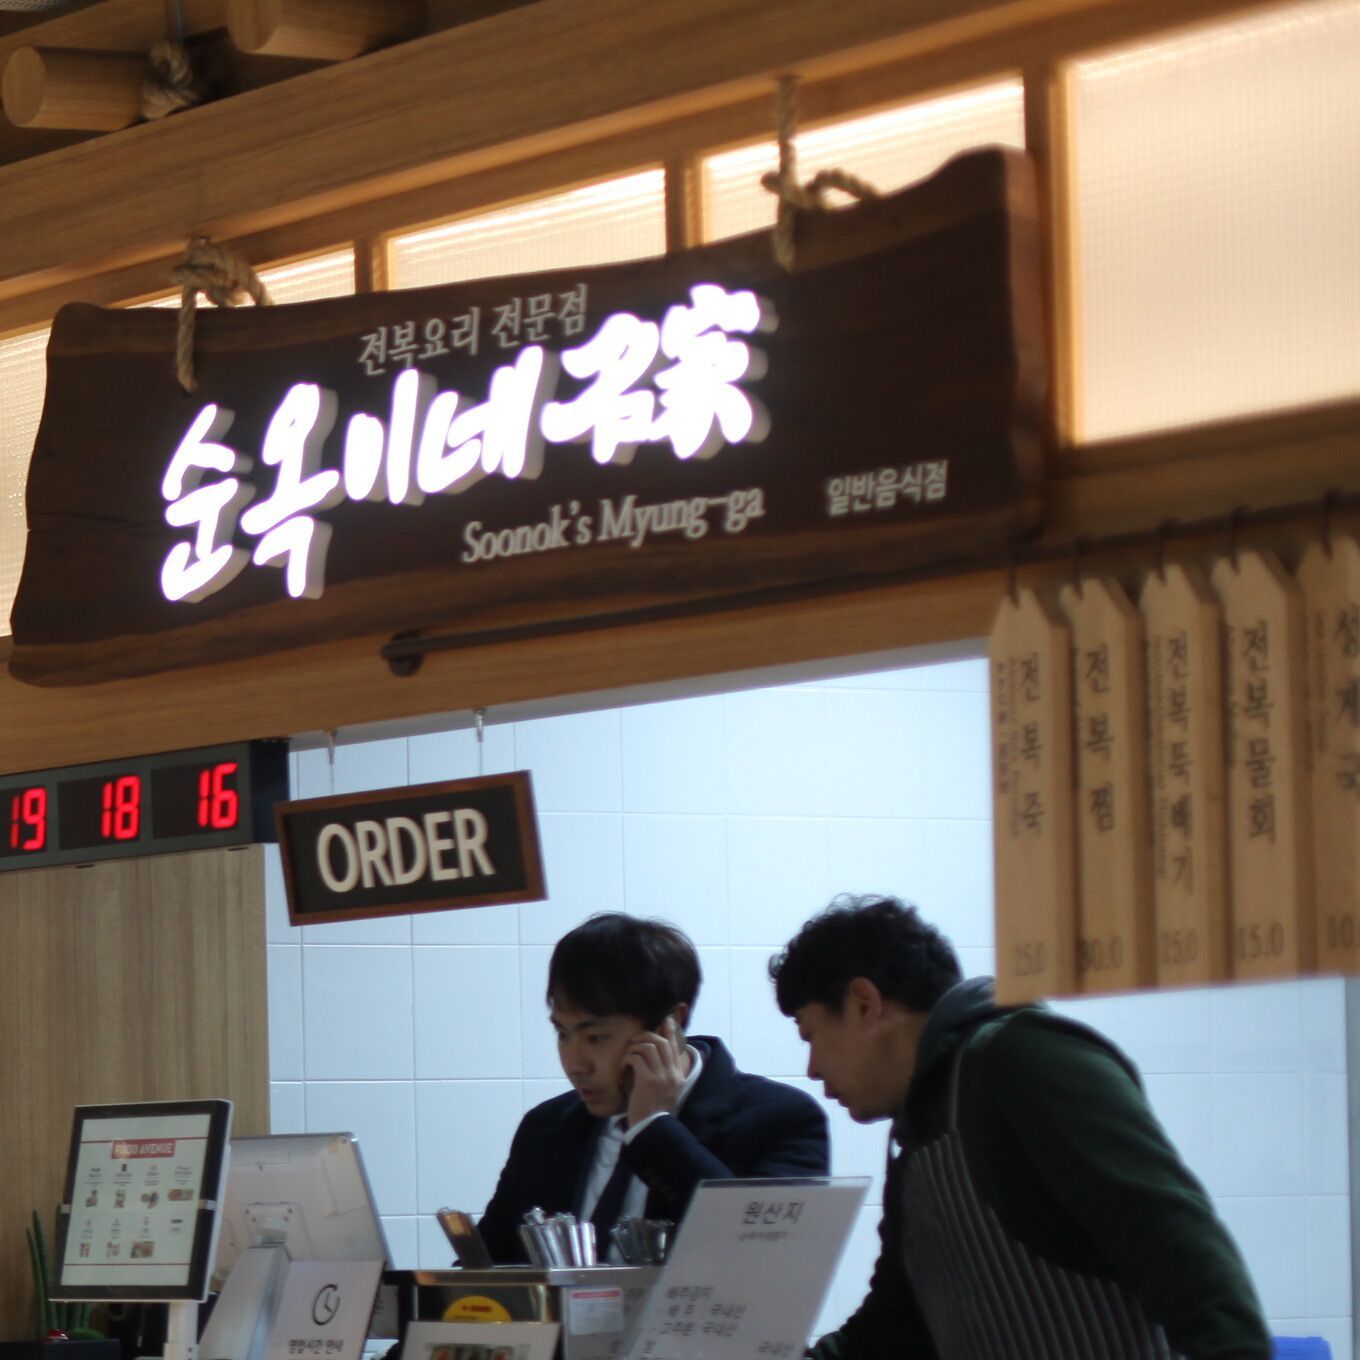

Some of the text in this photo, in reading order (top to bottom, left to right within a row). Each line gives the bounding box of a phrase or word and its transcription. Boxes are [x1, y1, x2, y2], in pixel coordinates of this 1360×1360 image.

[358, 282, 589, 377] 전복요리 전문점
[461, 486, 766, 563] Soonok's Myung-ga
[827, 459, 949, 517] 일반음식점
[1241, 619, 1277, 845] 전복물회
[11, 762, 238, 851] 19 18 16
[316, 808, 495, 898] ORDER
[743, 1201, 806, 1225] 원산지
